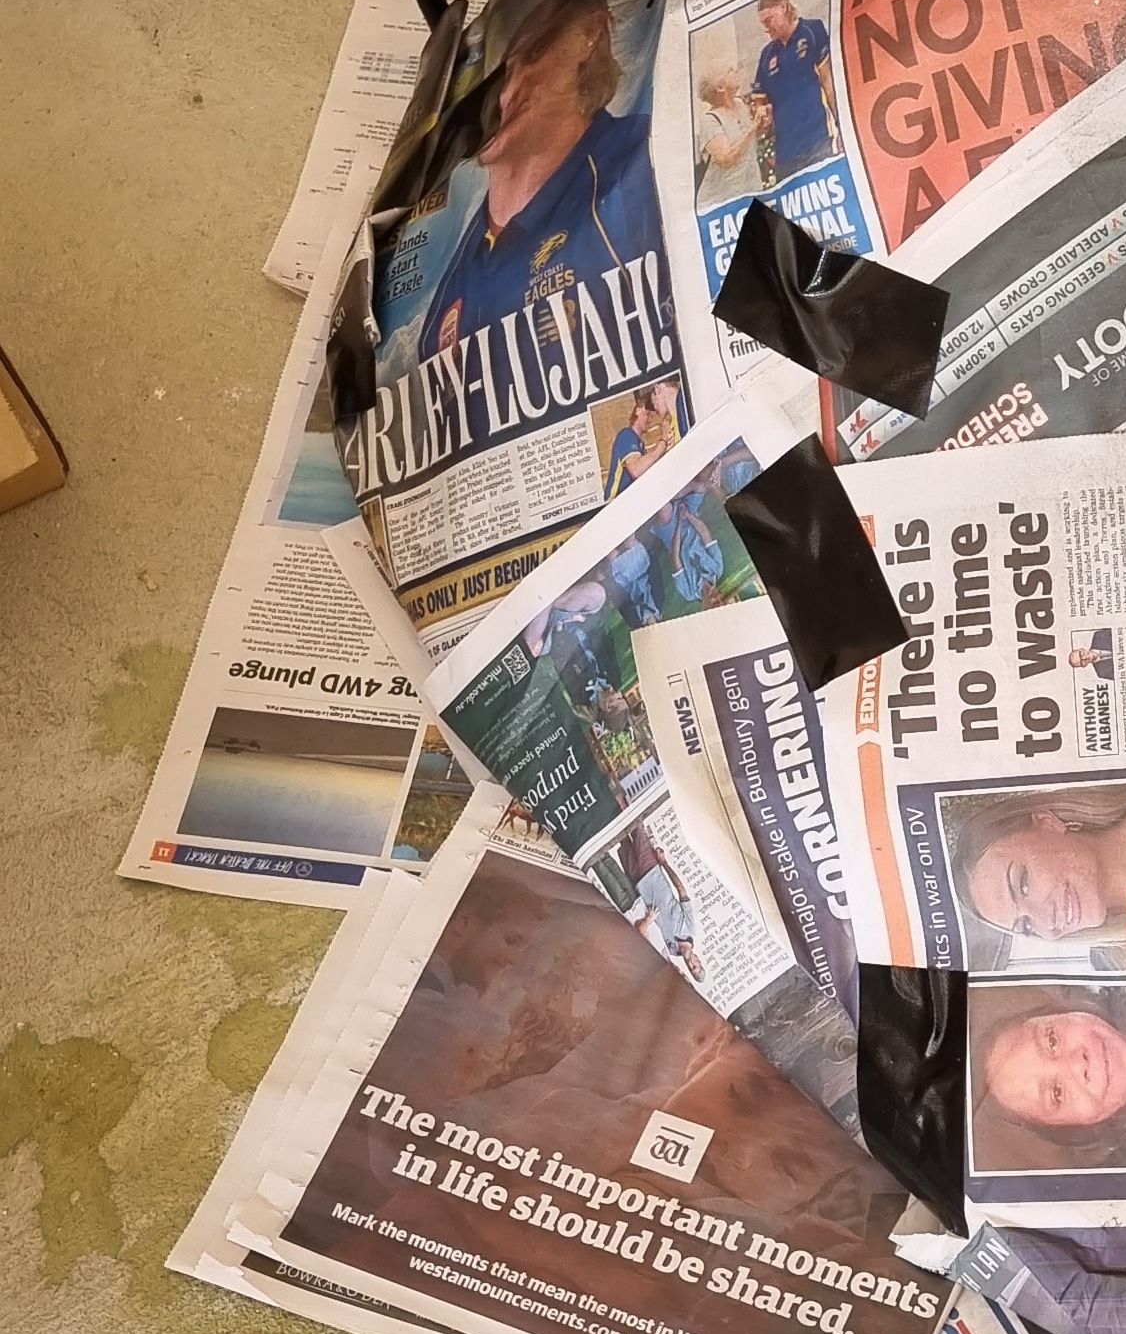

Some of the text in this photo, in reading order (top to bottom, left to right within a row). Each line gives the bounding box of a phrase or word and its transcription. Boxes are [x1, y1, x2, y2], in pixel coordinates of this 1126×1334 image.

[780, 174, 847, 220] WINS
[794, 206, 857, 244] NAL
[390, 253, 419, 280] start
[543, 263, 566, 279] COAST
[1049, 223, 1111, 276] ADELAIDE
[392, 272, 425, 297] Eagle
[524, 269, 576, 307] EAGLES
[999, 273, 1049, 311] CROWS
[1044, 260, 1107, 308] GEELONG
[1009, 303, 1045, 334] CATS
[729, 335, 768, 358] film
[951, 339, 997, 382] 4.30PM
[1091, 368, 1112, 387] OF
[541, 507, 564, 522] REPORT
[426, 581, 459, 616] ONLY
[461, 568, 494, 602] JUST
[493, 550, 541, 588] BEGUN
[1103, 572, 1113, 614] Aboriginal
[884, 517, 939, 760] 'There is
[943, 522, 1000, 743] no time
[997, 501, 1063, 759] to waste'
[228, 659, 423, 700] ng 4WD plunge
[858, 656, 879, 726] EDITO
[674, 695, 703, 756] NEWS
[1082, 685, 1098, 754] ANTHONY
[1095, 682, 1113, 753] ALBANESE
[509, 725, 568, 777] Limited spaces
[520, 744, 580, 812] purpos
[753, 647, 851, 922] CORNERING
[554, 781, 598, 832] Find
[184, 848, 218, 865] TRACK!
[720, 666, 838, 1000] claim major stake in Bunbury gem
[219, 852, 255, 869] BEATEN
[252, 857, 272, 871] THE
[270, 857, 293, 874] OFF
[905, 807, 952, 969] tics in war on DV
[359, 1084, 941, 1319] The most important moments
[391, 1143, 439, 1186] in
[437, 1159, 509, 1212] life
[508, 1193, 653, 1264] should
[651, 1237, 706, 1284] be
[331, 1200, 378, 1231] Mark
[376, 1218, 408, 1243] the
[406, 1230, 490, 1273] moments
[489, 1259, 528, 1288] that
[525, 1276, 578, 1306] mean
[577, 1292, 609, 1317] the
[607, 1307, 656, 1334] most
